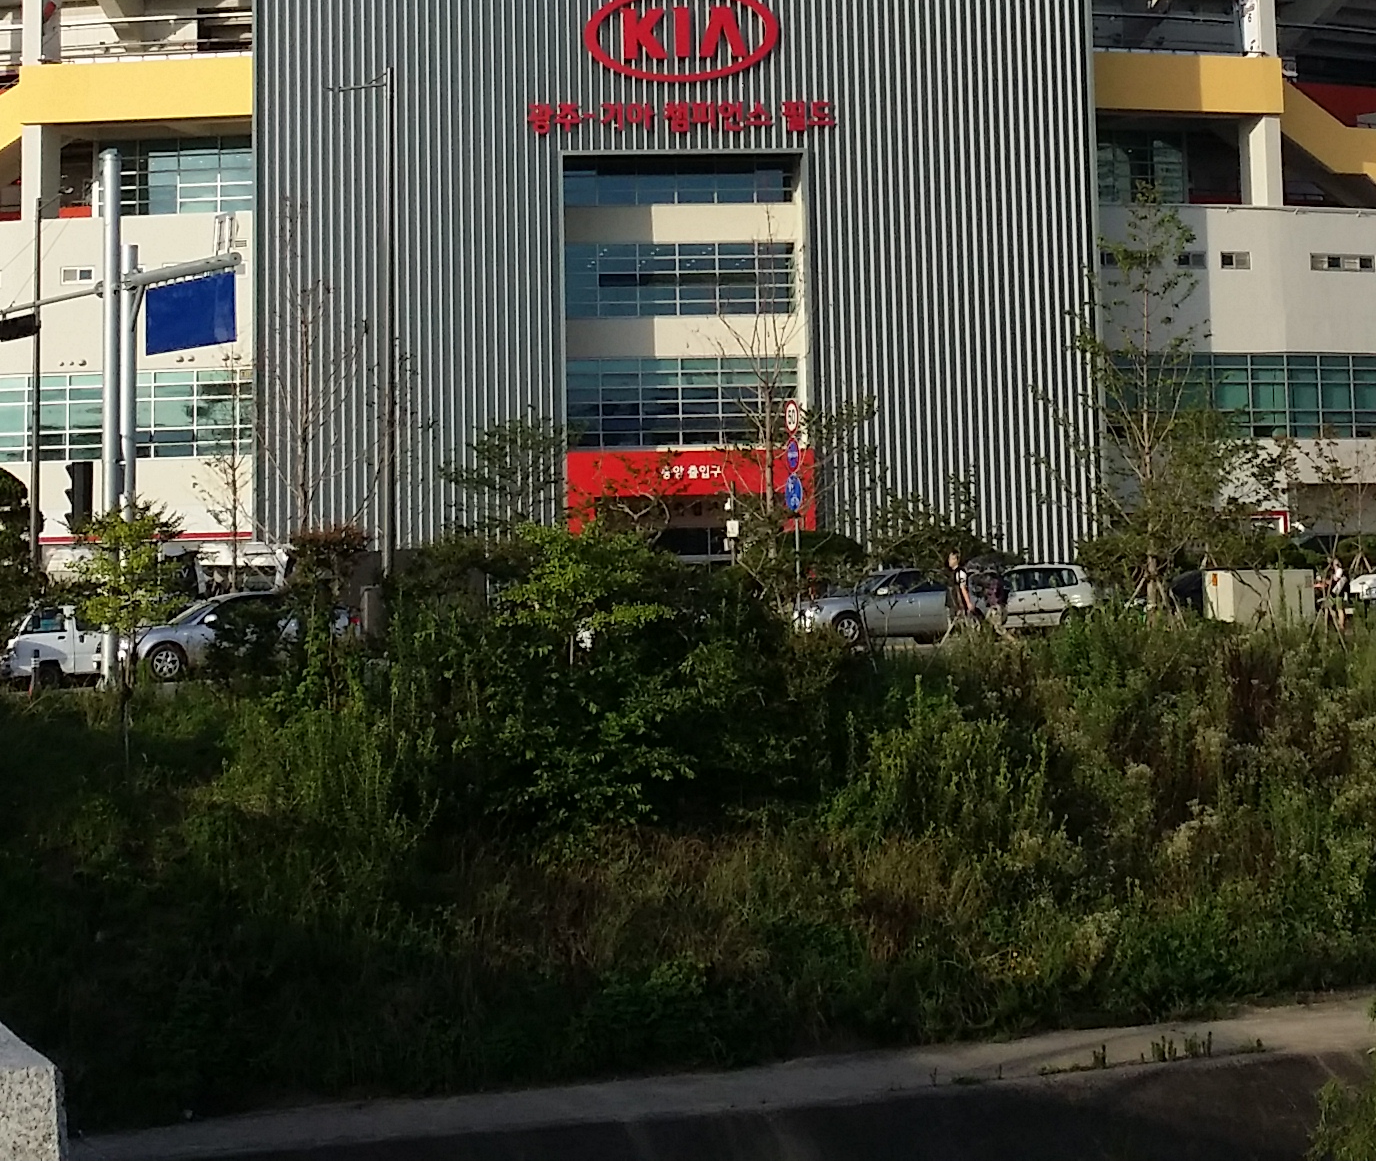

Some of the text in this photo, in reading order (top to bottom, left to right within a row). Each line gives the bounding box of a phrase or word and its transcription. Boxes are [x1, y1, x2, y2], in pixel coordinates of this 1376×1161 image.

[620, 6, 748, 60] KIA
[528, 100, 837, 135] 광주-기아 챔피언스 필드
[687, 464, 722, 480] 출입구
